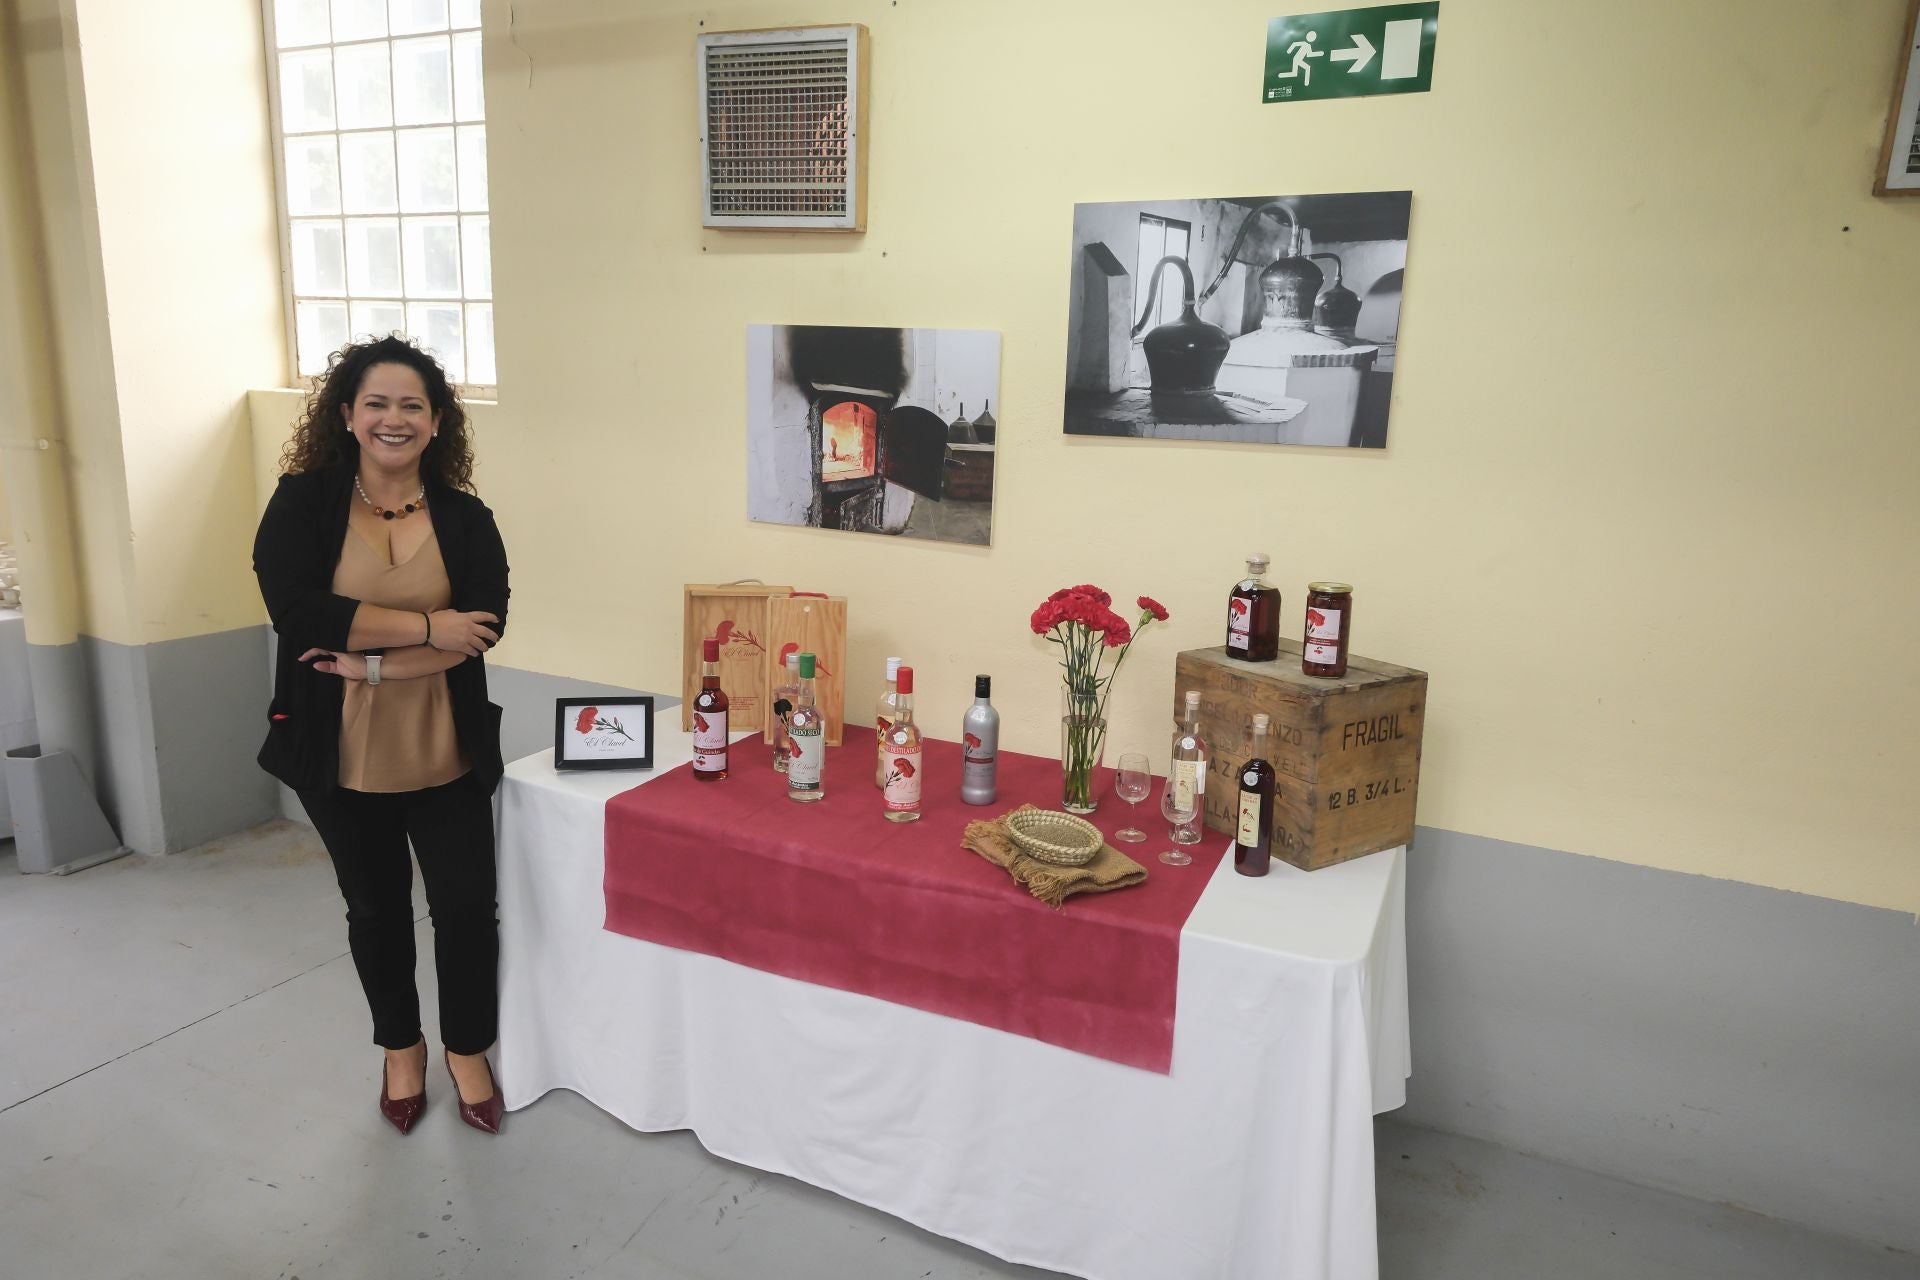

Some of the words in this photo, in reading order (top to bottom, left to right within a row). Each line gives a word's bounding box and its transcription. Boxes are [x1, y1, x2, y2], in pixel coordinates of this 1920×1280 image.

[600, 736, 627, 746] Clavel
[1343, 714, 1404, 751] FRAGIL
[1328, 791, 1342, 811] 12
[1347, 788, 1359, 806] B.
[1365, 779, 1389, 800] 3/4
